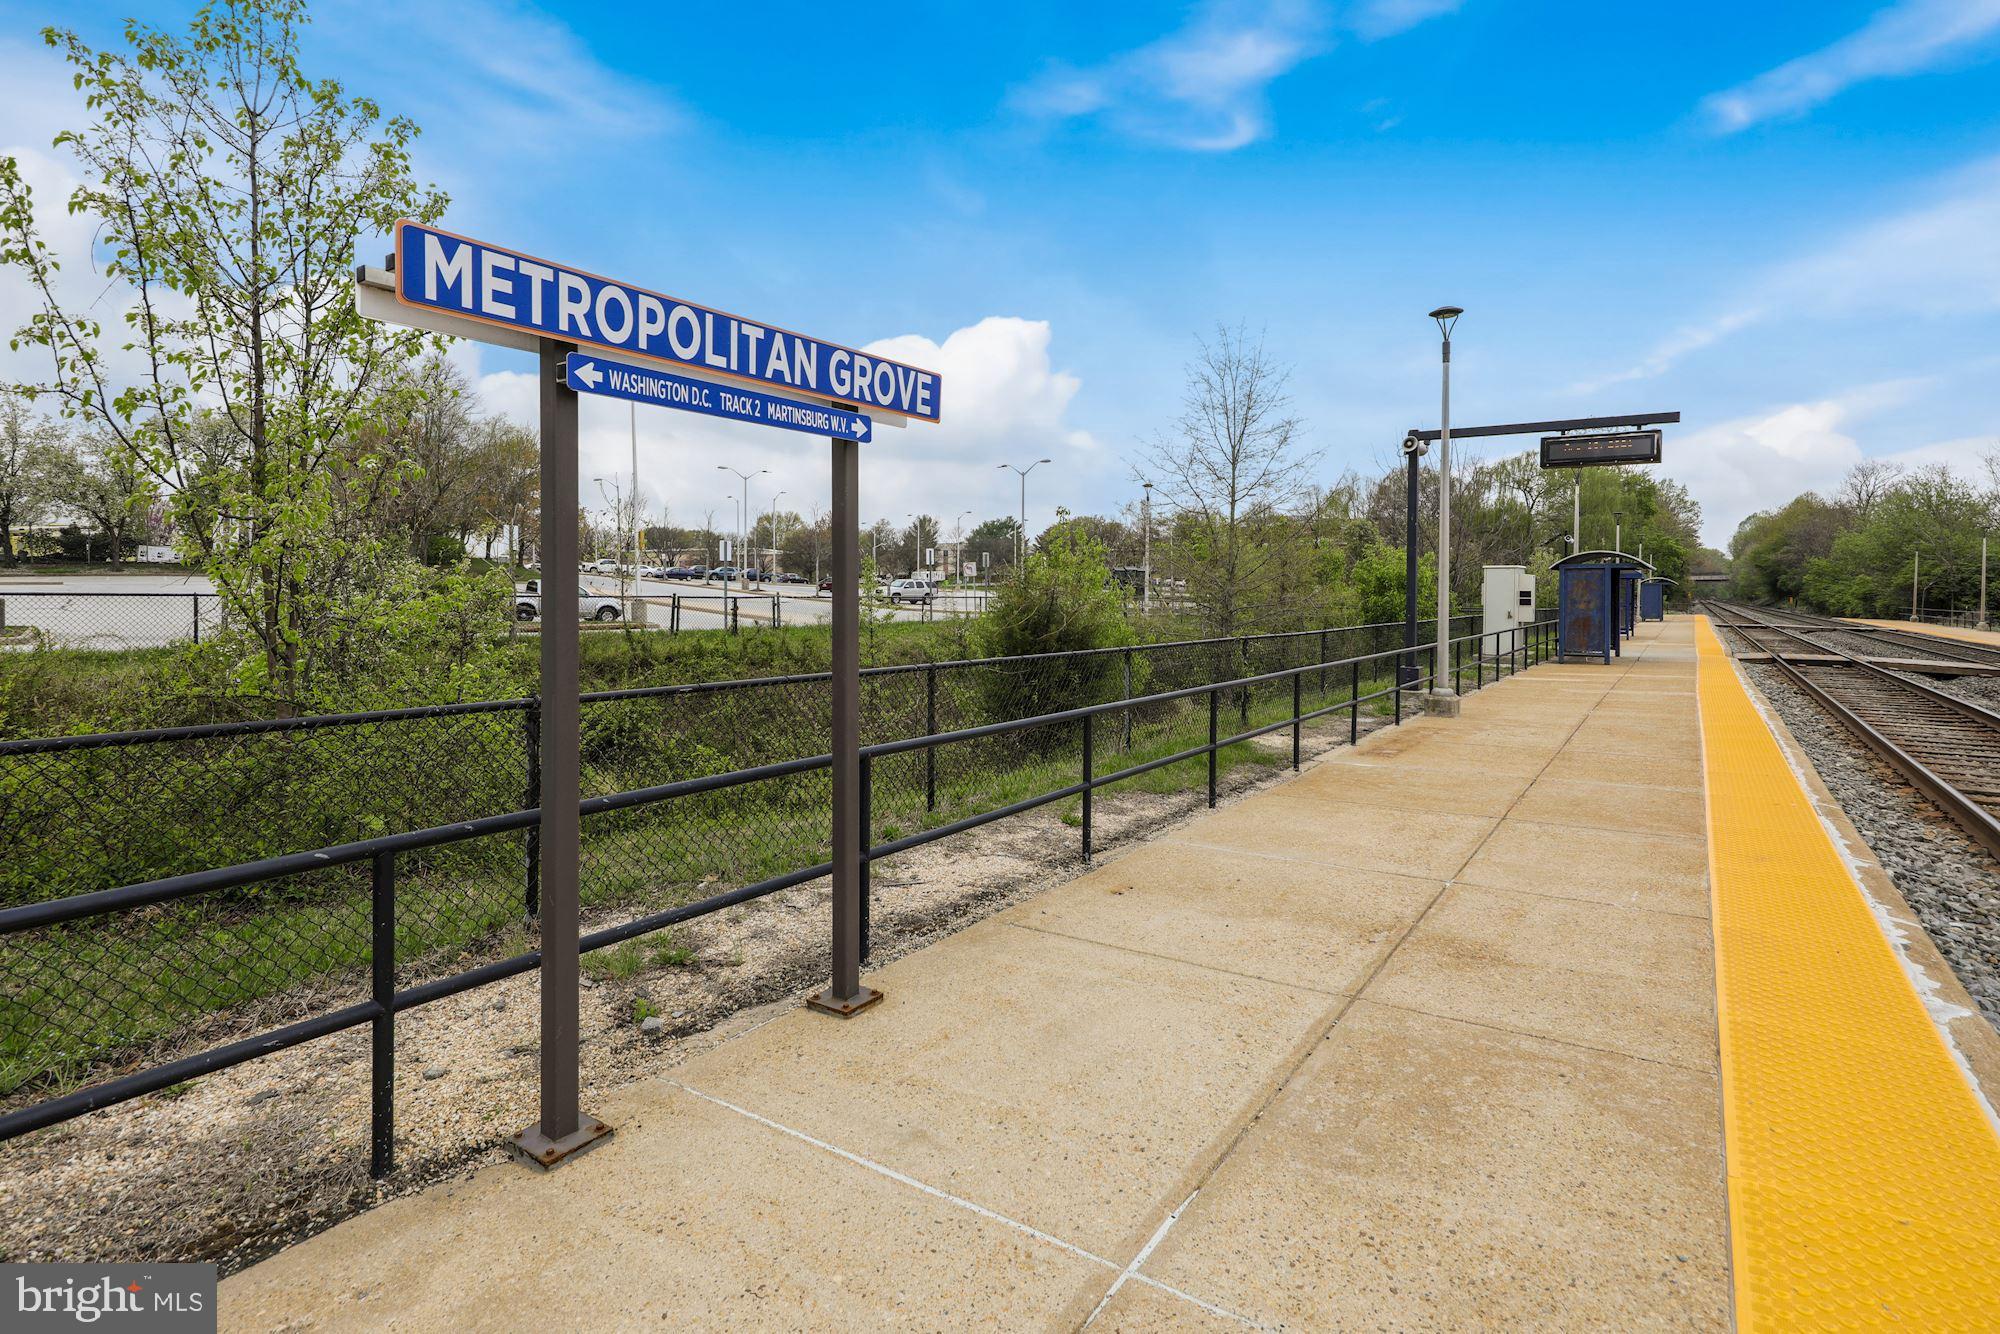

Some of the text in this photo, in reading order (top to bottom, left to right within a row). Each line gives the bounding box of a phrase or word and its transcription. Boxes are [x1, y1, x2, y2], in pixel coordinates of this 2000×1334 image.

[424, 233, 932, 416] METROPOLITAN GROVE
[608, 369, 849, 434] WASHINGTON D.C. TRACK 2 MARTINSBURG W.V.
